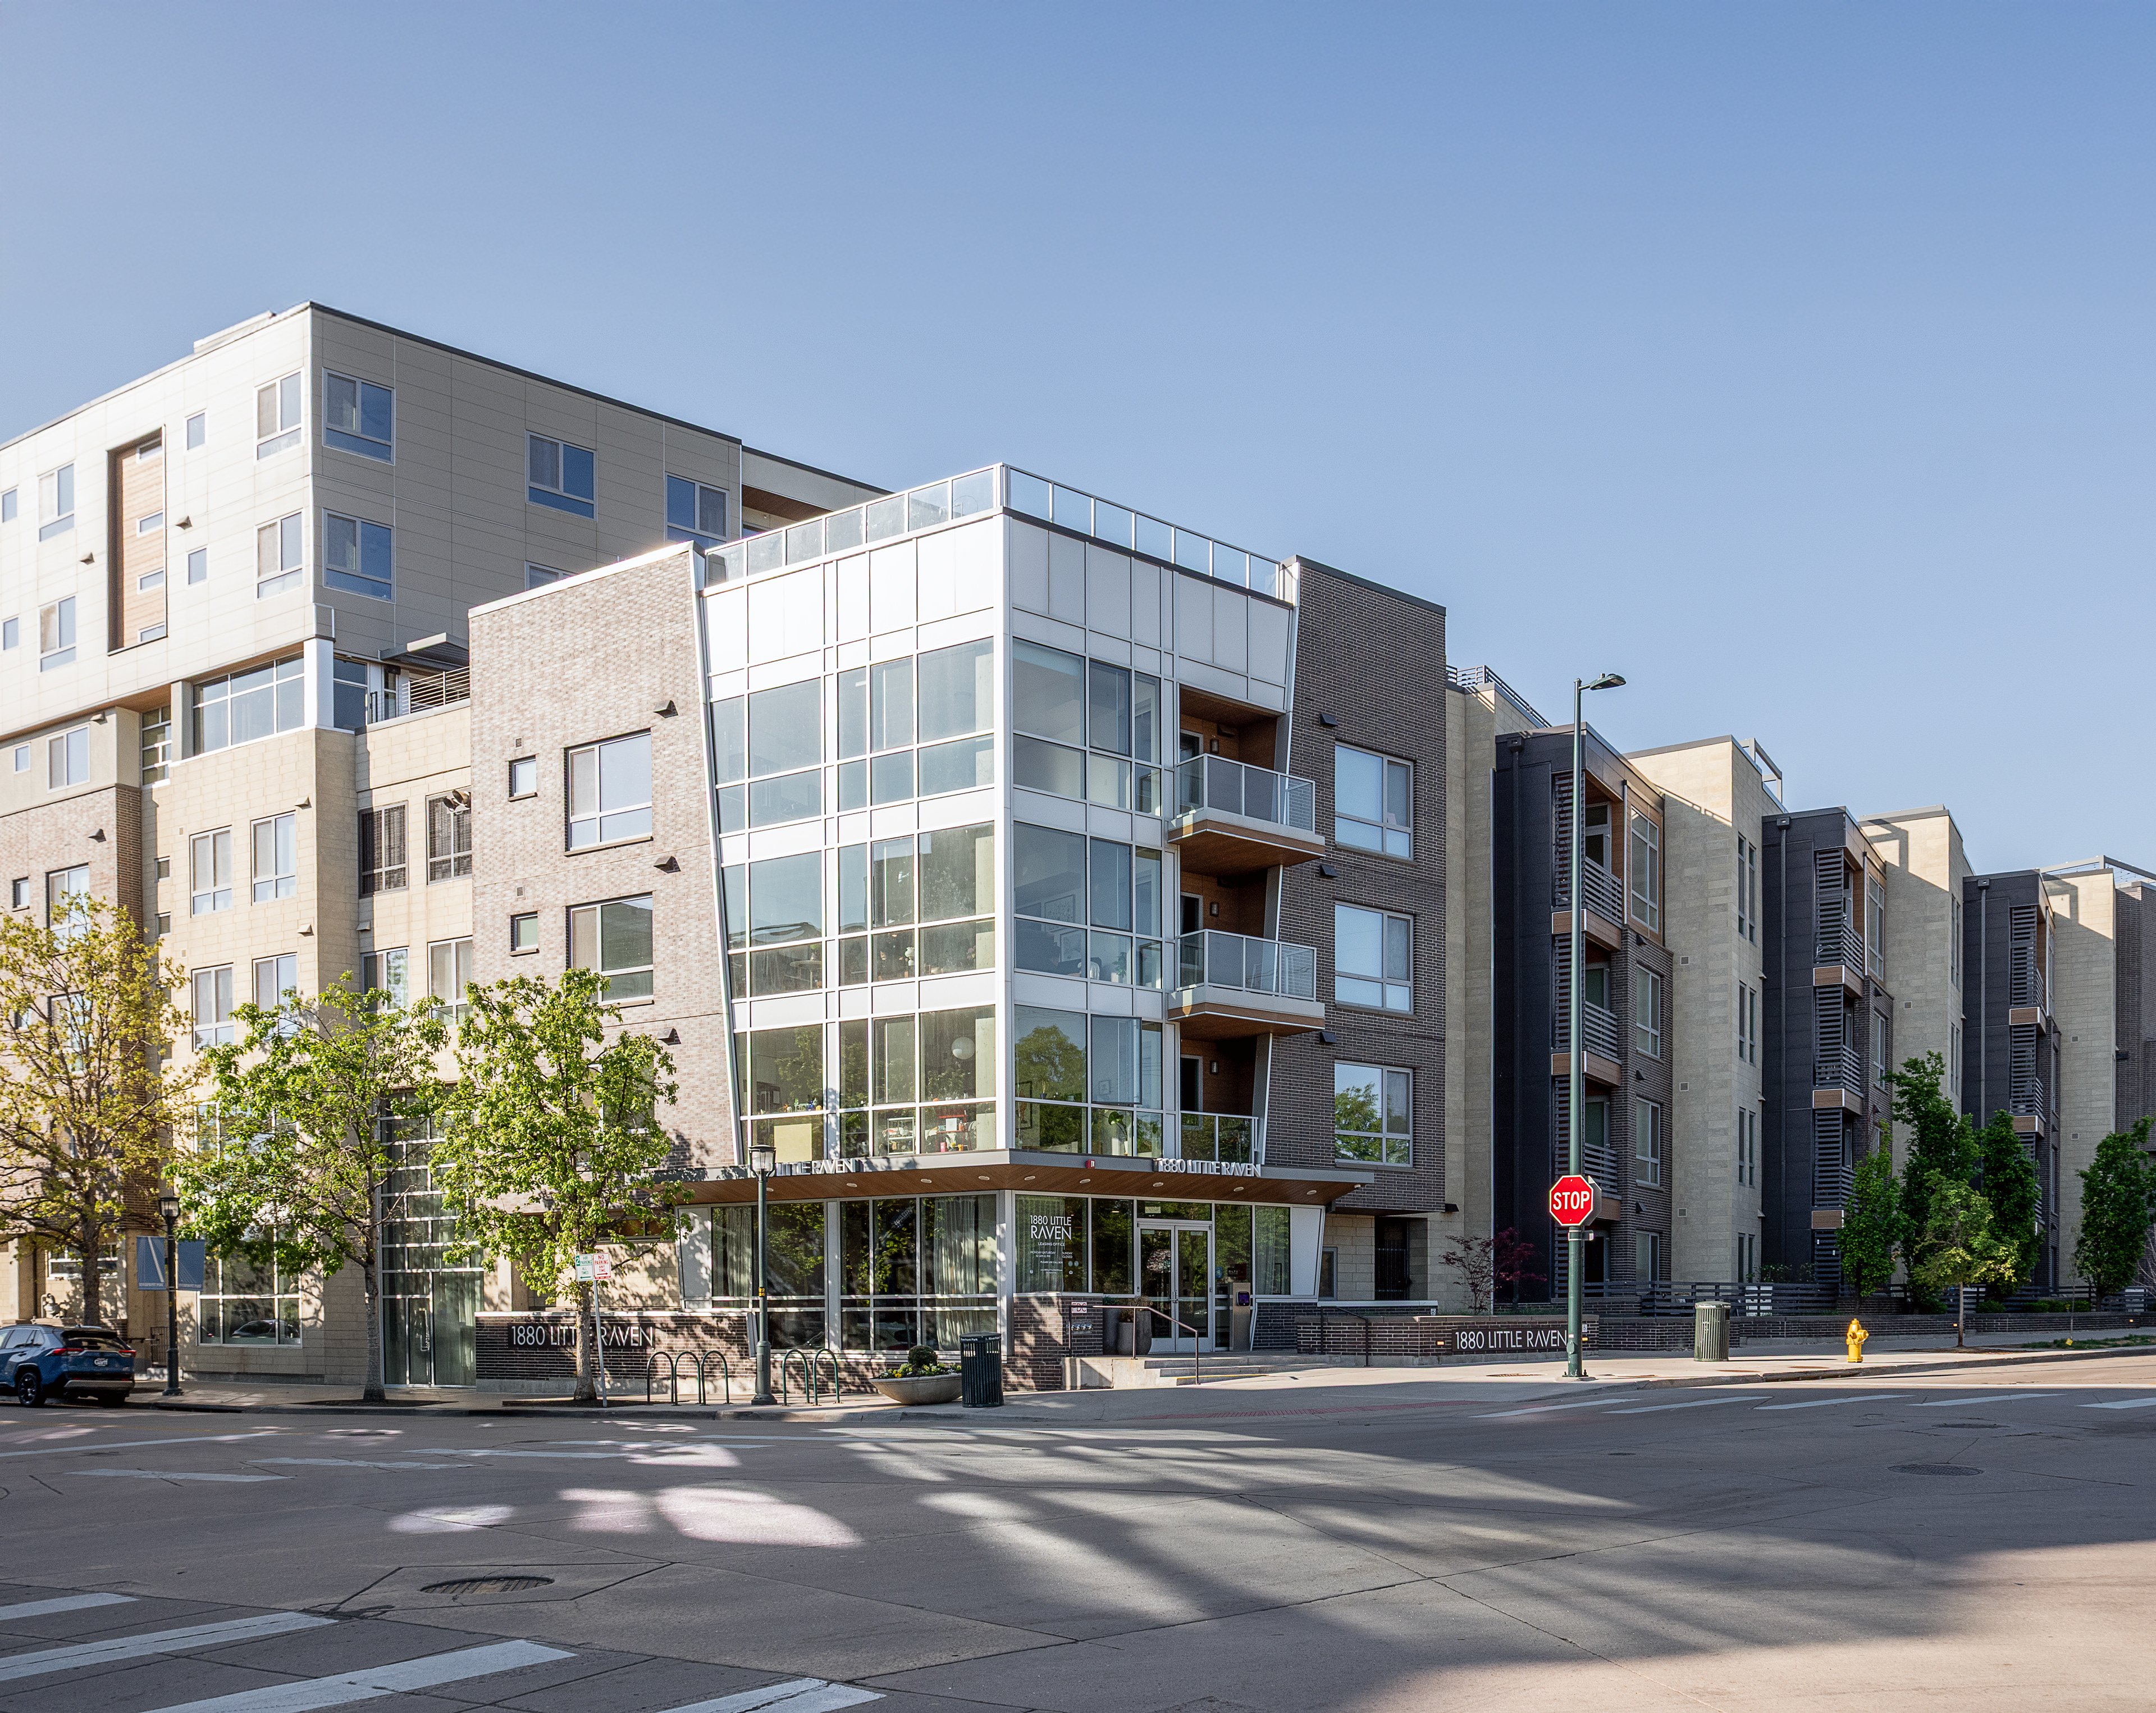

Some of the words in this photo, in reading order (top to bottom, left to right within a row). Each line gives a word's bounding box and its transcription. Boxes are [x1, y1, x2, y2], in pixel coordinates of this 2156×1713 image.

[812, 1158, 855, 1175] RAVEN
[1157, 1158, 1186, 1173] 1880
[1187, 1159, 1220, 1175] LITTLE
[1221, 1162, 1261, 1177] RAVEN
[1553, 1191, 1590, 1210] STOP
[1030, 1215, 1048, 1225] 1880
[1050, 1216, 1071, 1226] LITTLE
[1031, 1225, 1071, 1240] RAVEN
[1072, 1303, 1086, 1312] FDC
[511, 1326, 545, 1345] 1880
[550, 1326, 592, 1345] LITT
[599, 1326, 653, 1346] RAVEN
[1455, 1331, 1484, 1349] 1880
[1488, 1331, 1522, 1348] LITTLE
[1527, 1330, 1567, 1347] RAVEN
